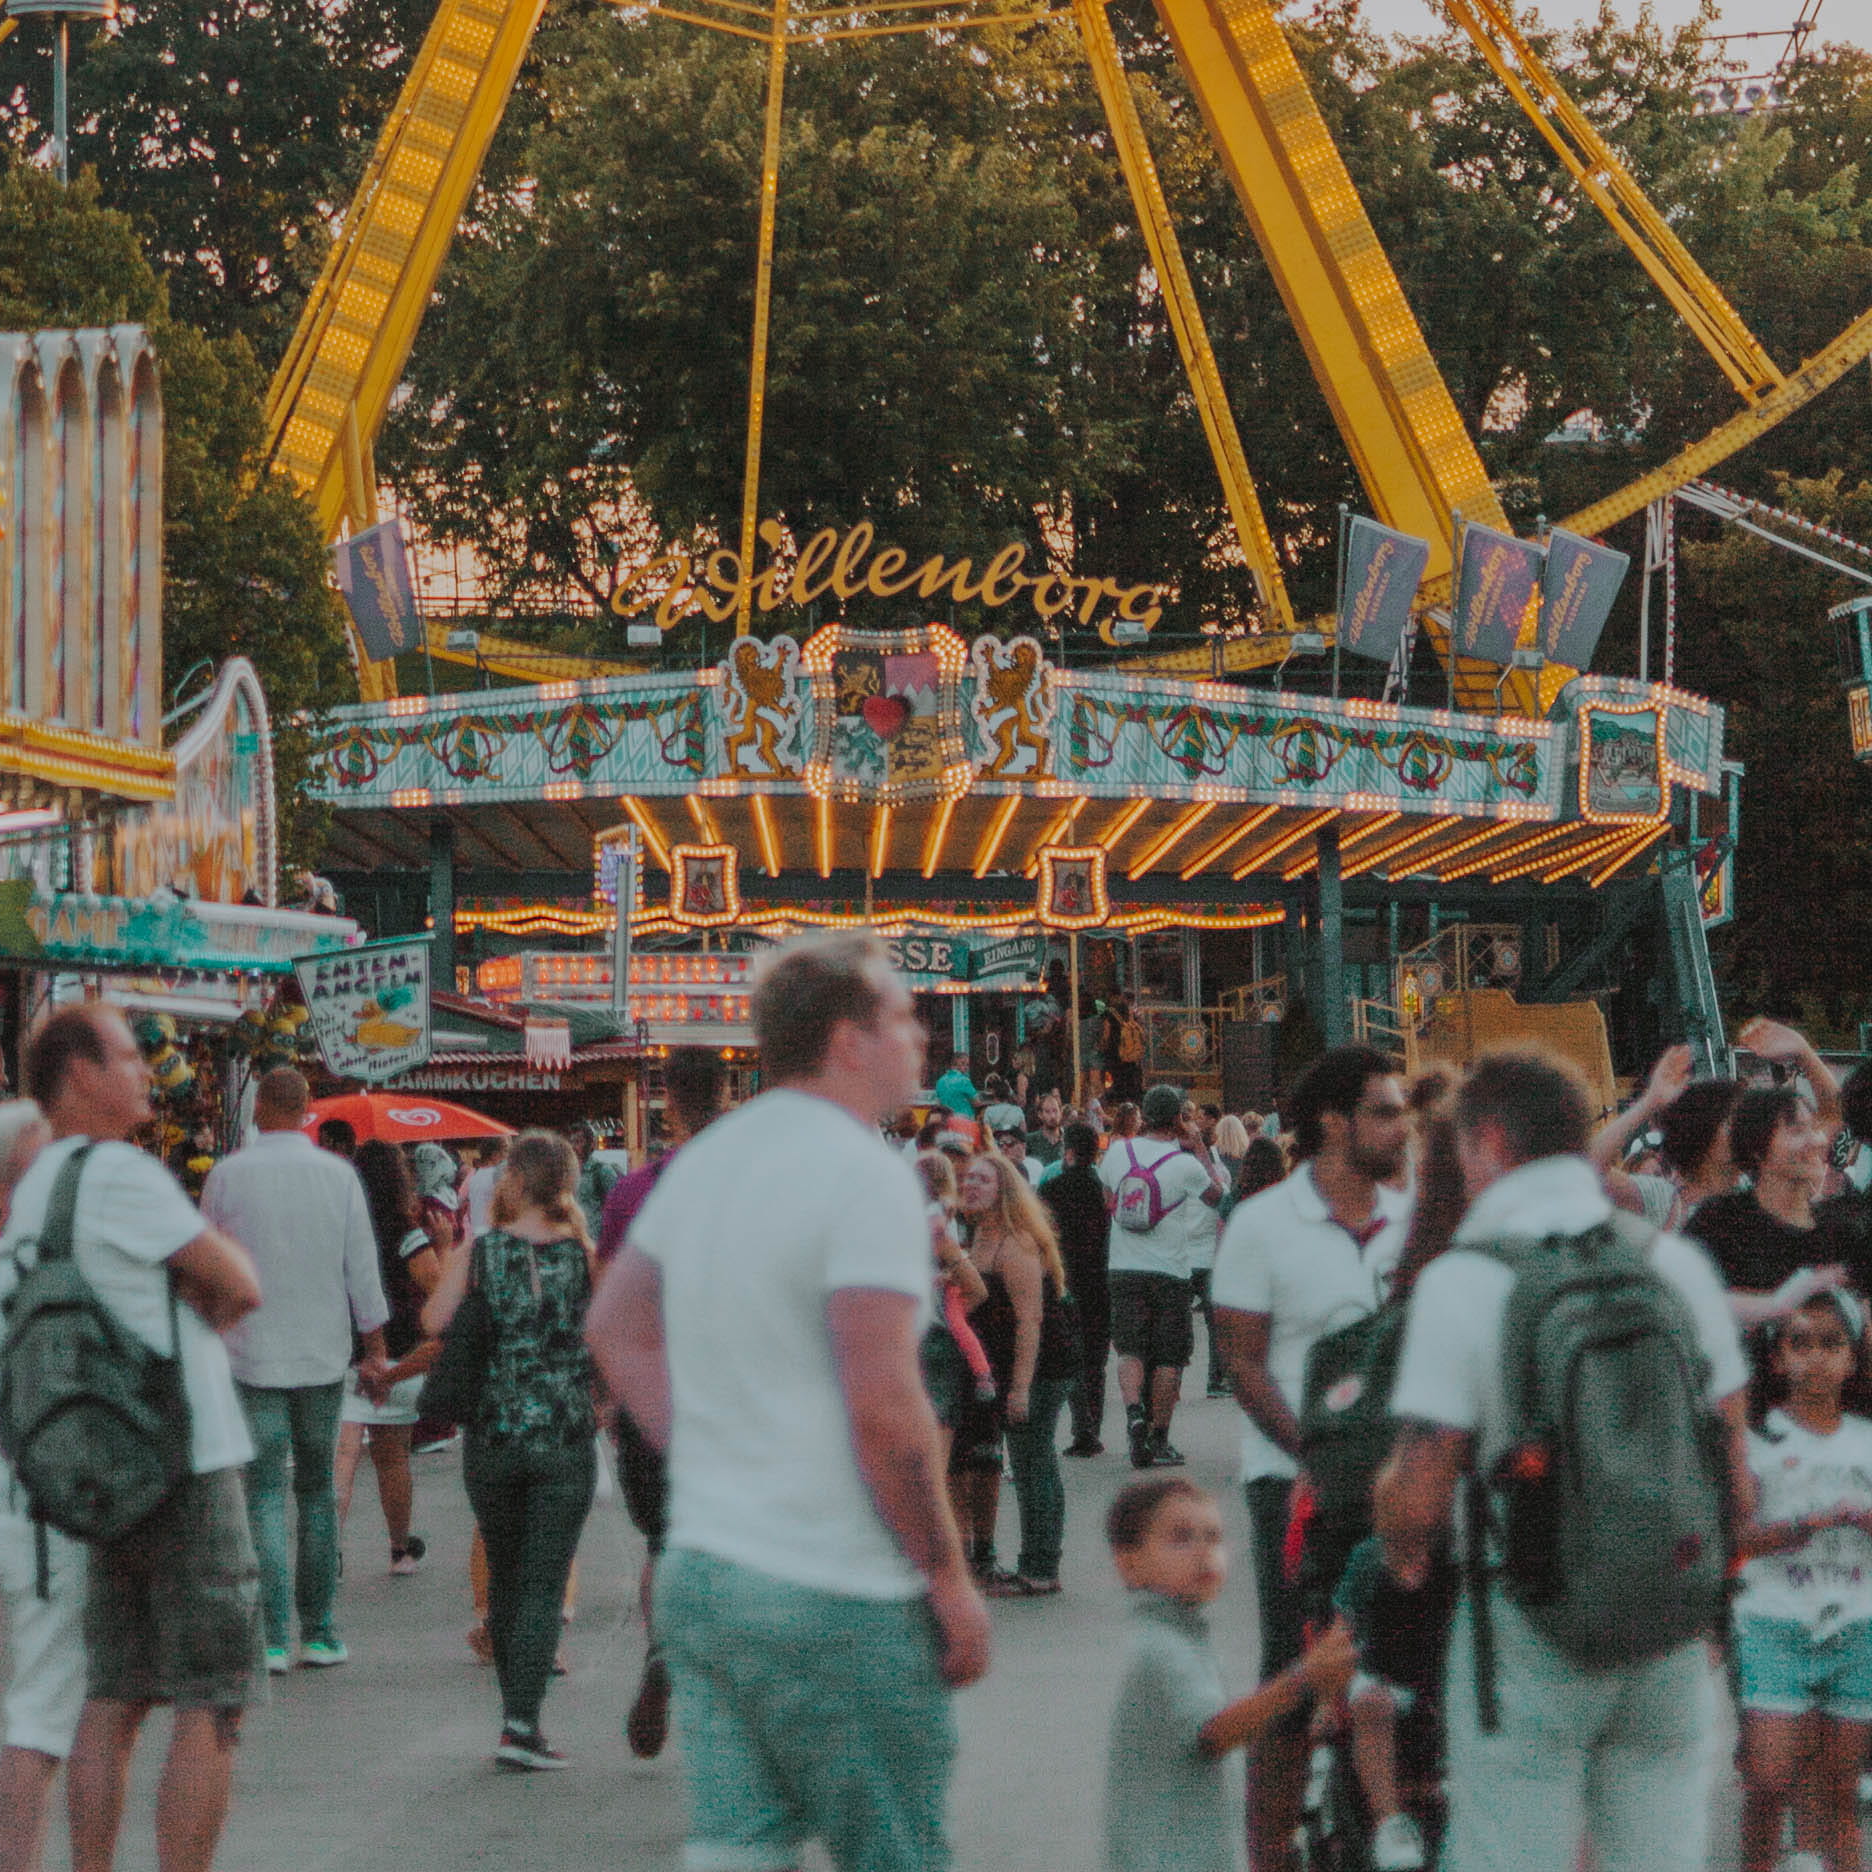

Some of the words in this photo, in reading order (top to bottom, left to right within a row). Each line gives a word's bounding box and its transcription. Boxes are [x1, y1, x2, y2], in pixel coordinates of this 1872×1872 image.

[611, 518, 1162, 646] Willenborg
[885, 939, 954, 971] SSE
[983, 938, 1036, 965] EINGANG
